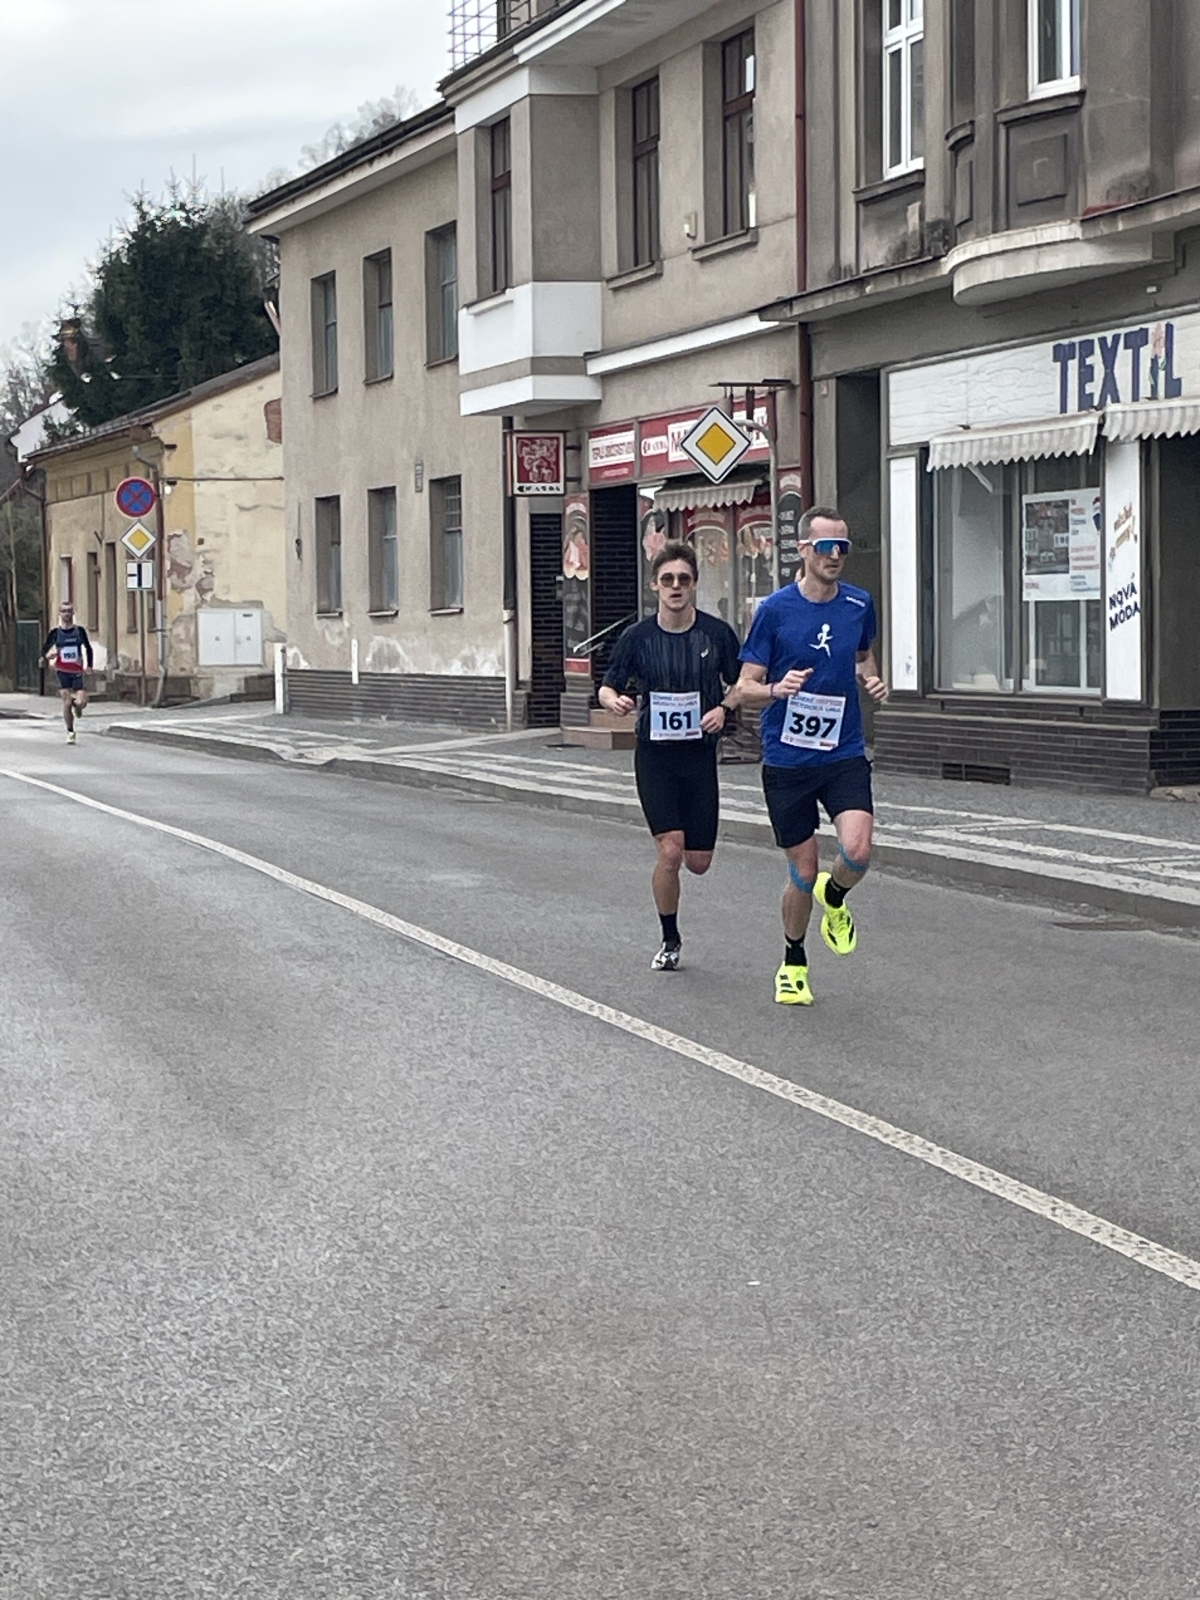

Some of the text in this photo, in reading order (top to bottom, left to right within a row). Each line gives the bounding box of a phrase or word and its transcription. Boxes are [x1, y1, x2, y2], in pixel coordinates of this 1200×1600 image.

[1052, 321, 1182, 415] TEXTIL
[658, 710, 692, 730] 161
[788, 711, 838, 738] 397
